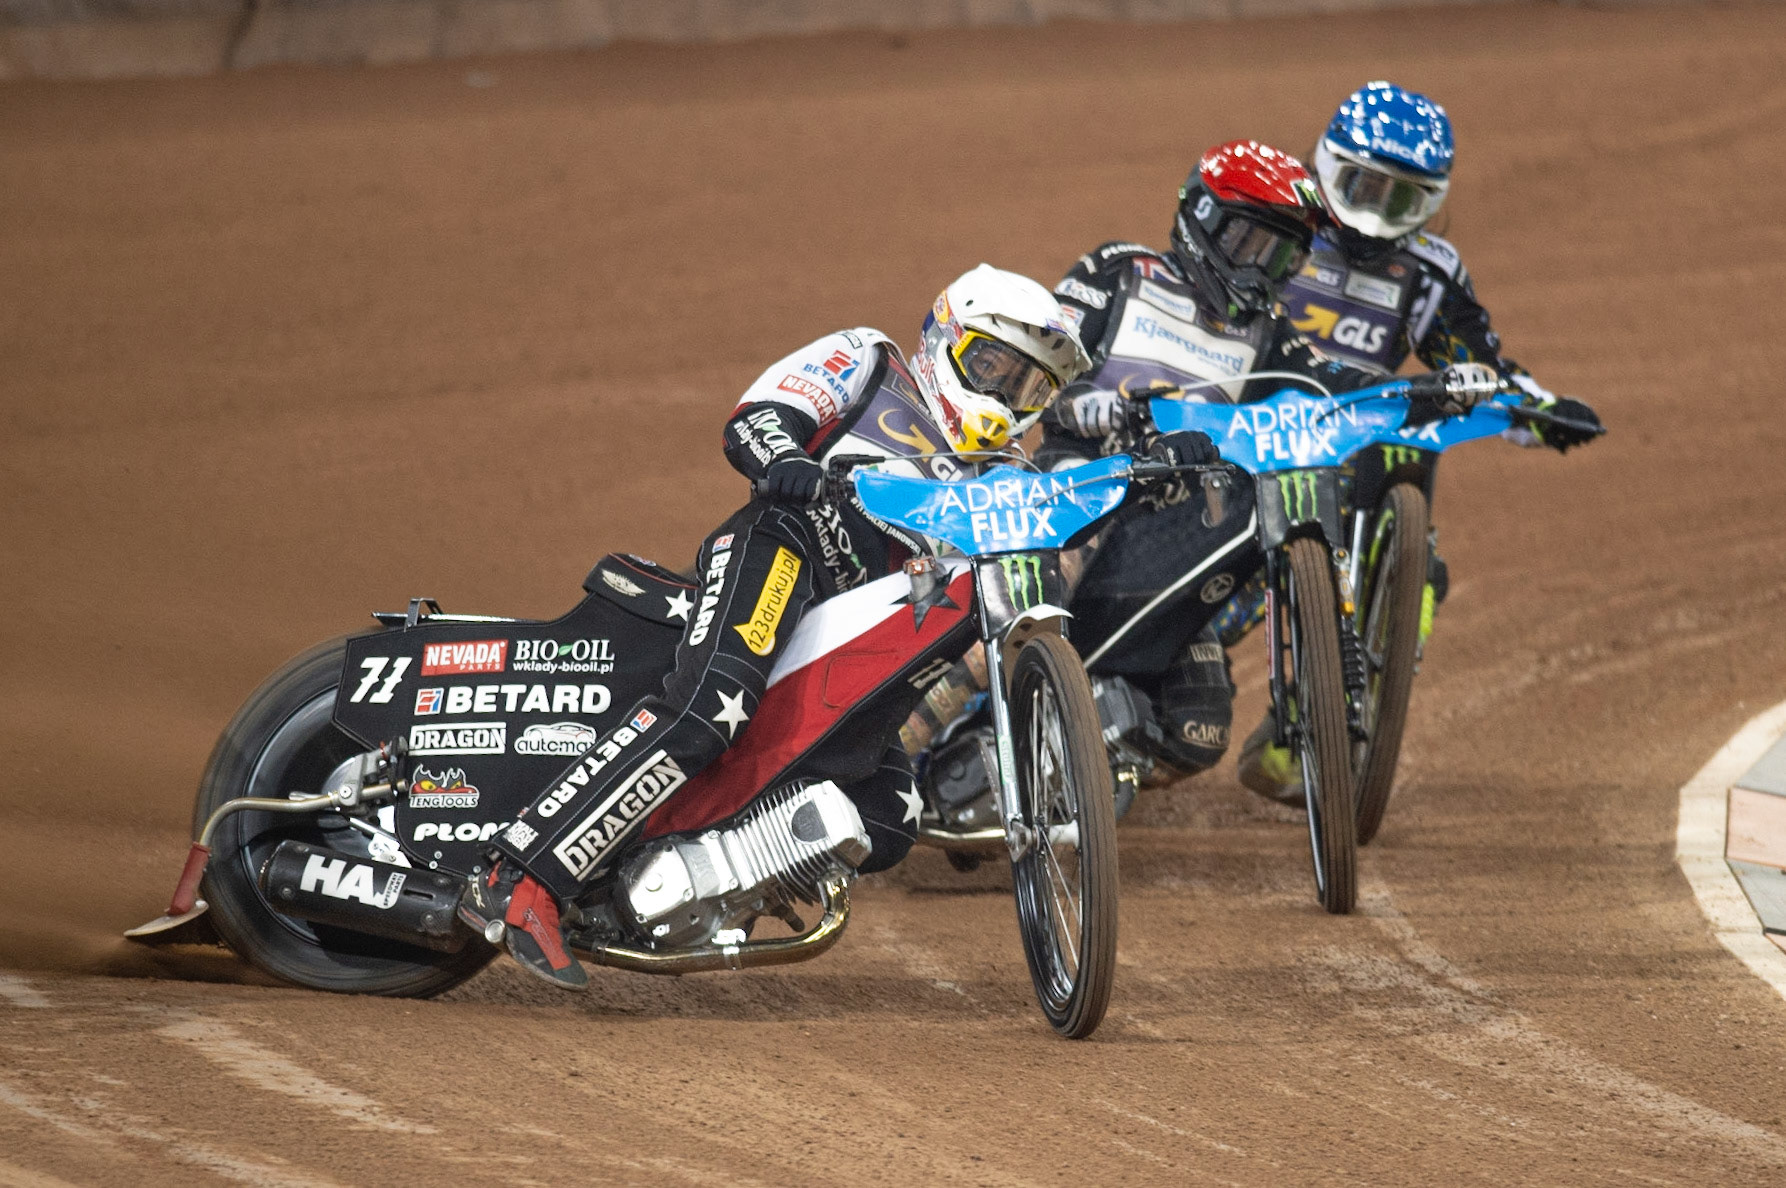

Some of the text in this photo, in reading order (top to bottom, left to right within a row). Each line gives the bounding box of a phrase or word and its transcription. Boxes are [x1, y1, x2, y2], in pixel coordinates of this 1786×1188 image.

[1333, 316, 1388, 354] GLS
[782, 376, 835, 418] NEVADA
[803, 363, 849, 403] BETARD
[1228, 400, 1358, 439] ADRIAN
[1255, 428, 1337, 463] FLUX
[930, 456, 963, 482] GL
[940, 476, 1076, 516] ADRIAN
[971, 507, 1058, 543] FLUX
[689, 551, 732, 646] BETARD
[748, 552, 798, 649] 123drukuj.pl
[426, 643, 501, 667] NEVADA
[460, 662, 500, 671] PARTS
[513, 661, 614, 675] wklady-biooil.pl
[350, 657, 412, 703] 71
[445, 684, 612, 714] BETARD
[409, 727, 506, 751] DRAGON
[537, 726, 638, 817] BETARD
[562, 753, 688, 874] DRAGON
[383, 873, 399, 906] SPEEDWAY
[393, 875, 404, 895] PARTS
